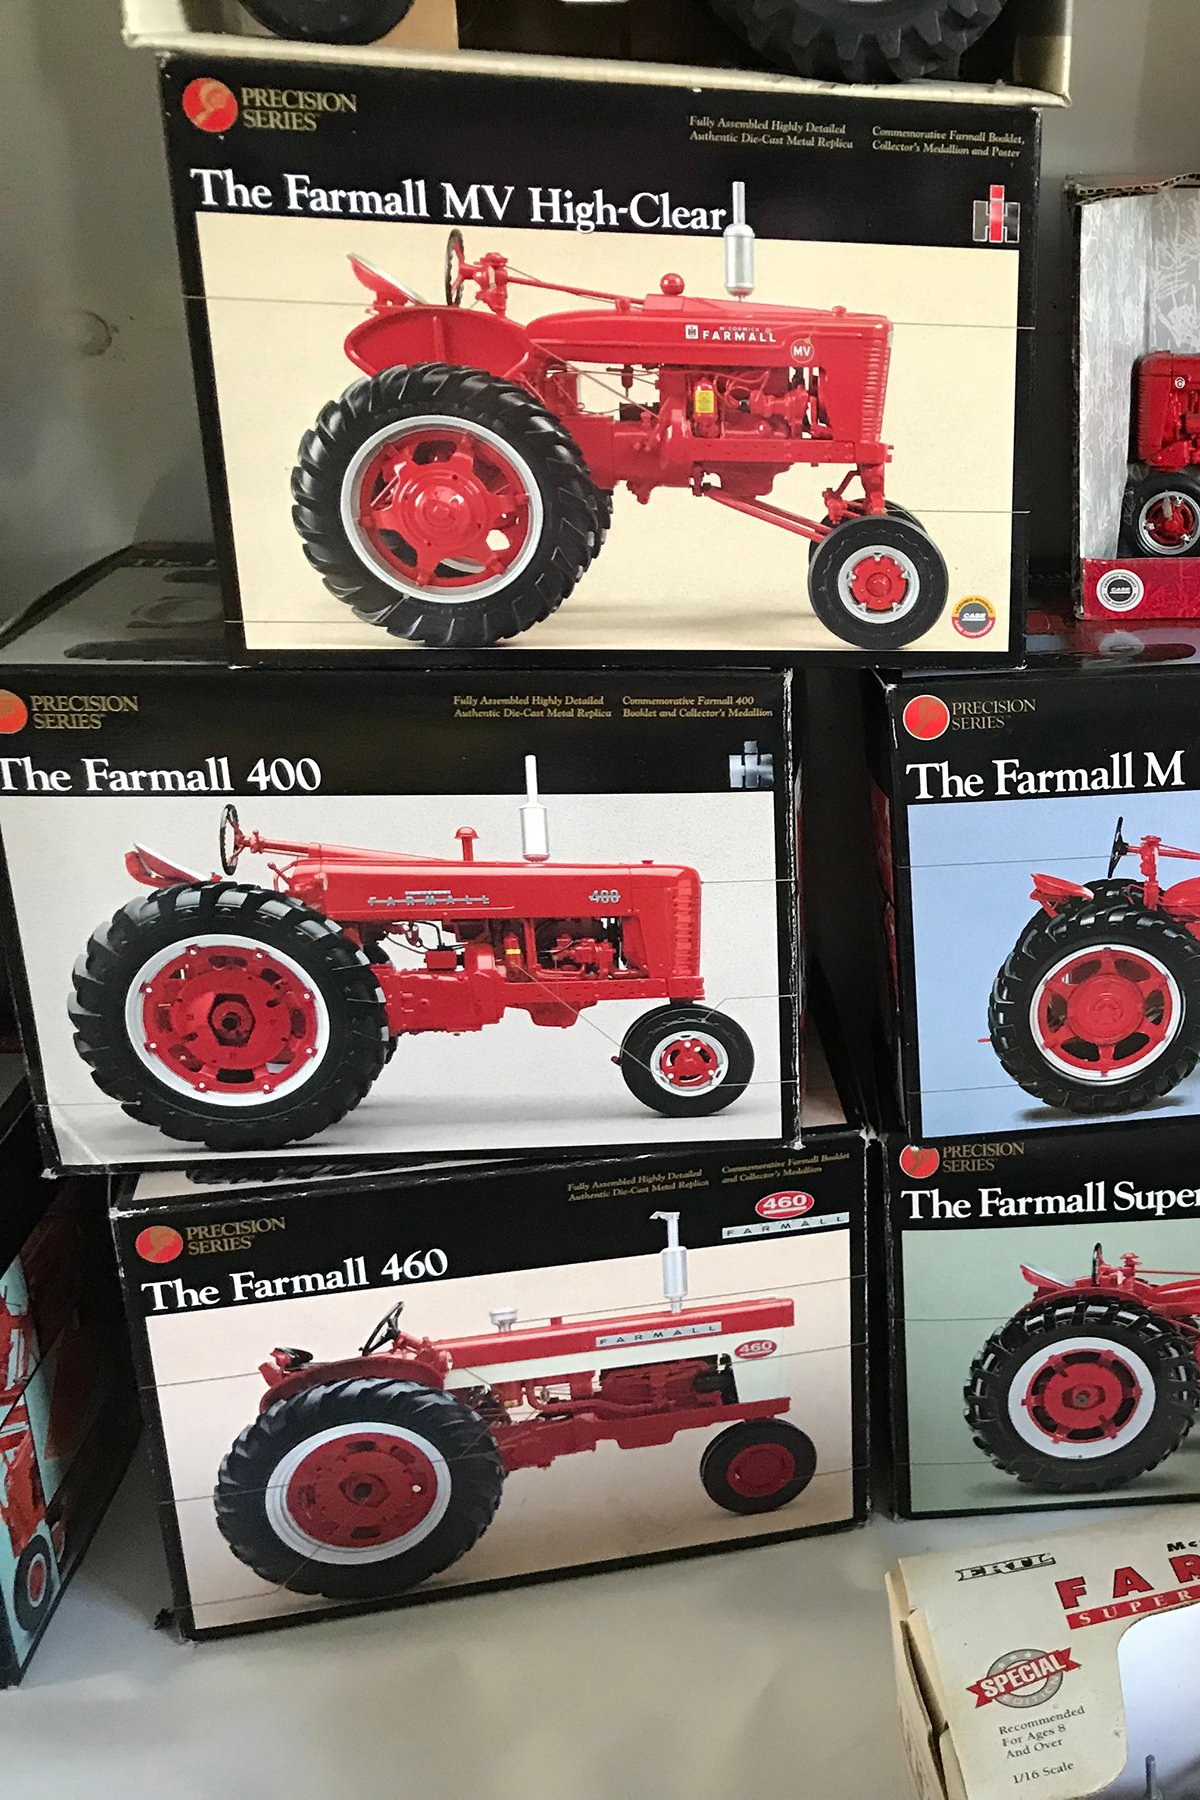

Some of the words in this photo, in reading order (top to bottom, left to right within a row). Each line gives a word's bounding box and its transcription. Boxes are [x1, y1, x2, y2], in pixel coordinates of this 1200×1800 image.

[240, 87, 357, 113] PRECISION
[242, 112, 318, 131] SERIES
[689, 115, 715, 128] Fully
[717, 117, 769, 130] Assembled
[771, 120, 802, 133] Highly
[805, 121, 846, 134] Detailed
[689, 130, 738, 143] Authentic
[741, 132, 784, 145] Die-Cast
[786, 135, 815, 147] Metal
[817, 136, 853, 150] Replica
[872, 125, 946, 140] Commemorative
[949, 130, 986, 142] Farmall
[988, 131, 1025, 146] Booklet,
[872, 139, 920, 152] Collector's
[922, 142, 970, 155] Medallion
[971, 146, 989, 156] and
[991, 146, 1021, 158] Poster
[190, 168, 272, 209] The
[283, 173, 428, 217] Farmall
[441, 182, 514, 220] MV
[529, 186, 727, 234] High-Clear
[702, 330, 777, 343] FARMALL
[792, 345, 811, 358] MV
[30, 694, 139, 712] PRECISION
[453, 695, 478, 707] Fully
[480, 694, 529, 706] Assembled
[531, 694, 562, 707] Highly
[564, 695, 605, 706] Detailed
[622, 694, 695, 706] Commemorative
[697, 695, 733, 706] Farmall
[736, 695, 755, 706] 400
[951, 698, 1037, 716] PRECISION
[33, 712, 103, 730] SERIES
[454, 708, 500, 718] Authentic
[503, 707, 544, 718] Die-Cast
[546, 708, 574, 718] Metal
[577, 707, 612, 719] Replica
[622, 707, 657, 718] Booklet
[659, 708, 676, 718] and
[679, 708, 725, 718] Collector's
[728, 707, 774, 718] Medallion
[951, 714, 1012, 731] SERIES
[0, 757, 73, 792] The
[80, 757, 235, 792] Farmall
[246, 756, 322, 792] 400
[905, 760, 985, 800] The
[992, 751, 1136, 797] Farmall
[1143, 750, 1186, 788] M
[367, 895, 490, 907] FARMALL
[943, 1141, 1025, 1160] PRECISION
[942, 1157, 996, 1173] SERIES
[568, 1183, 590, 1192] Fully
[762, 1194, 808, 1210] 460
[900, 1187, 972, 1219] The
[978, 1181, 1107, 1218] Farmall
[185, 1216, 286, 1241] PRECISION
[726, 1216, 845, 1237] FARMALL
[187, 1234, 252, 1256] SERIES
[141, 1276, 221, 1311] The
[229, 1255, 370, 1301] Farmall
[380, 1247, 449, 1282] 460
[600, 1325, 717, 1345] FARMALL
[739, 1340, 773, 1354] 460
[954, 1553, 1057, 1582] ERTL
[980, 1653, 1068, 1699] SPECIAL
[999, 1705, 1086, 1736] Recommended
[1002, 1736, 1023, 1748] For
[1027, 1727, 1056, 1745] Ages
[1057, 1724, 1067, 1734] 8
[1006, 1744, 1031, 1760] And
[1033, 1737, 1064, 1752] Over
[1012, 1770, 1040, 1785] 1/16
[1042, 1760, 1075, 1778] Scale
